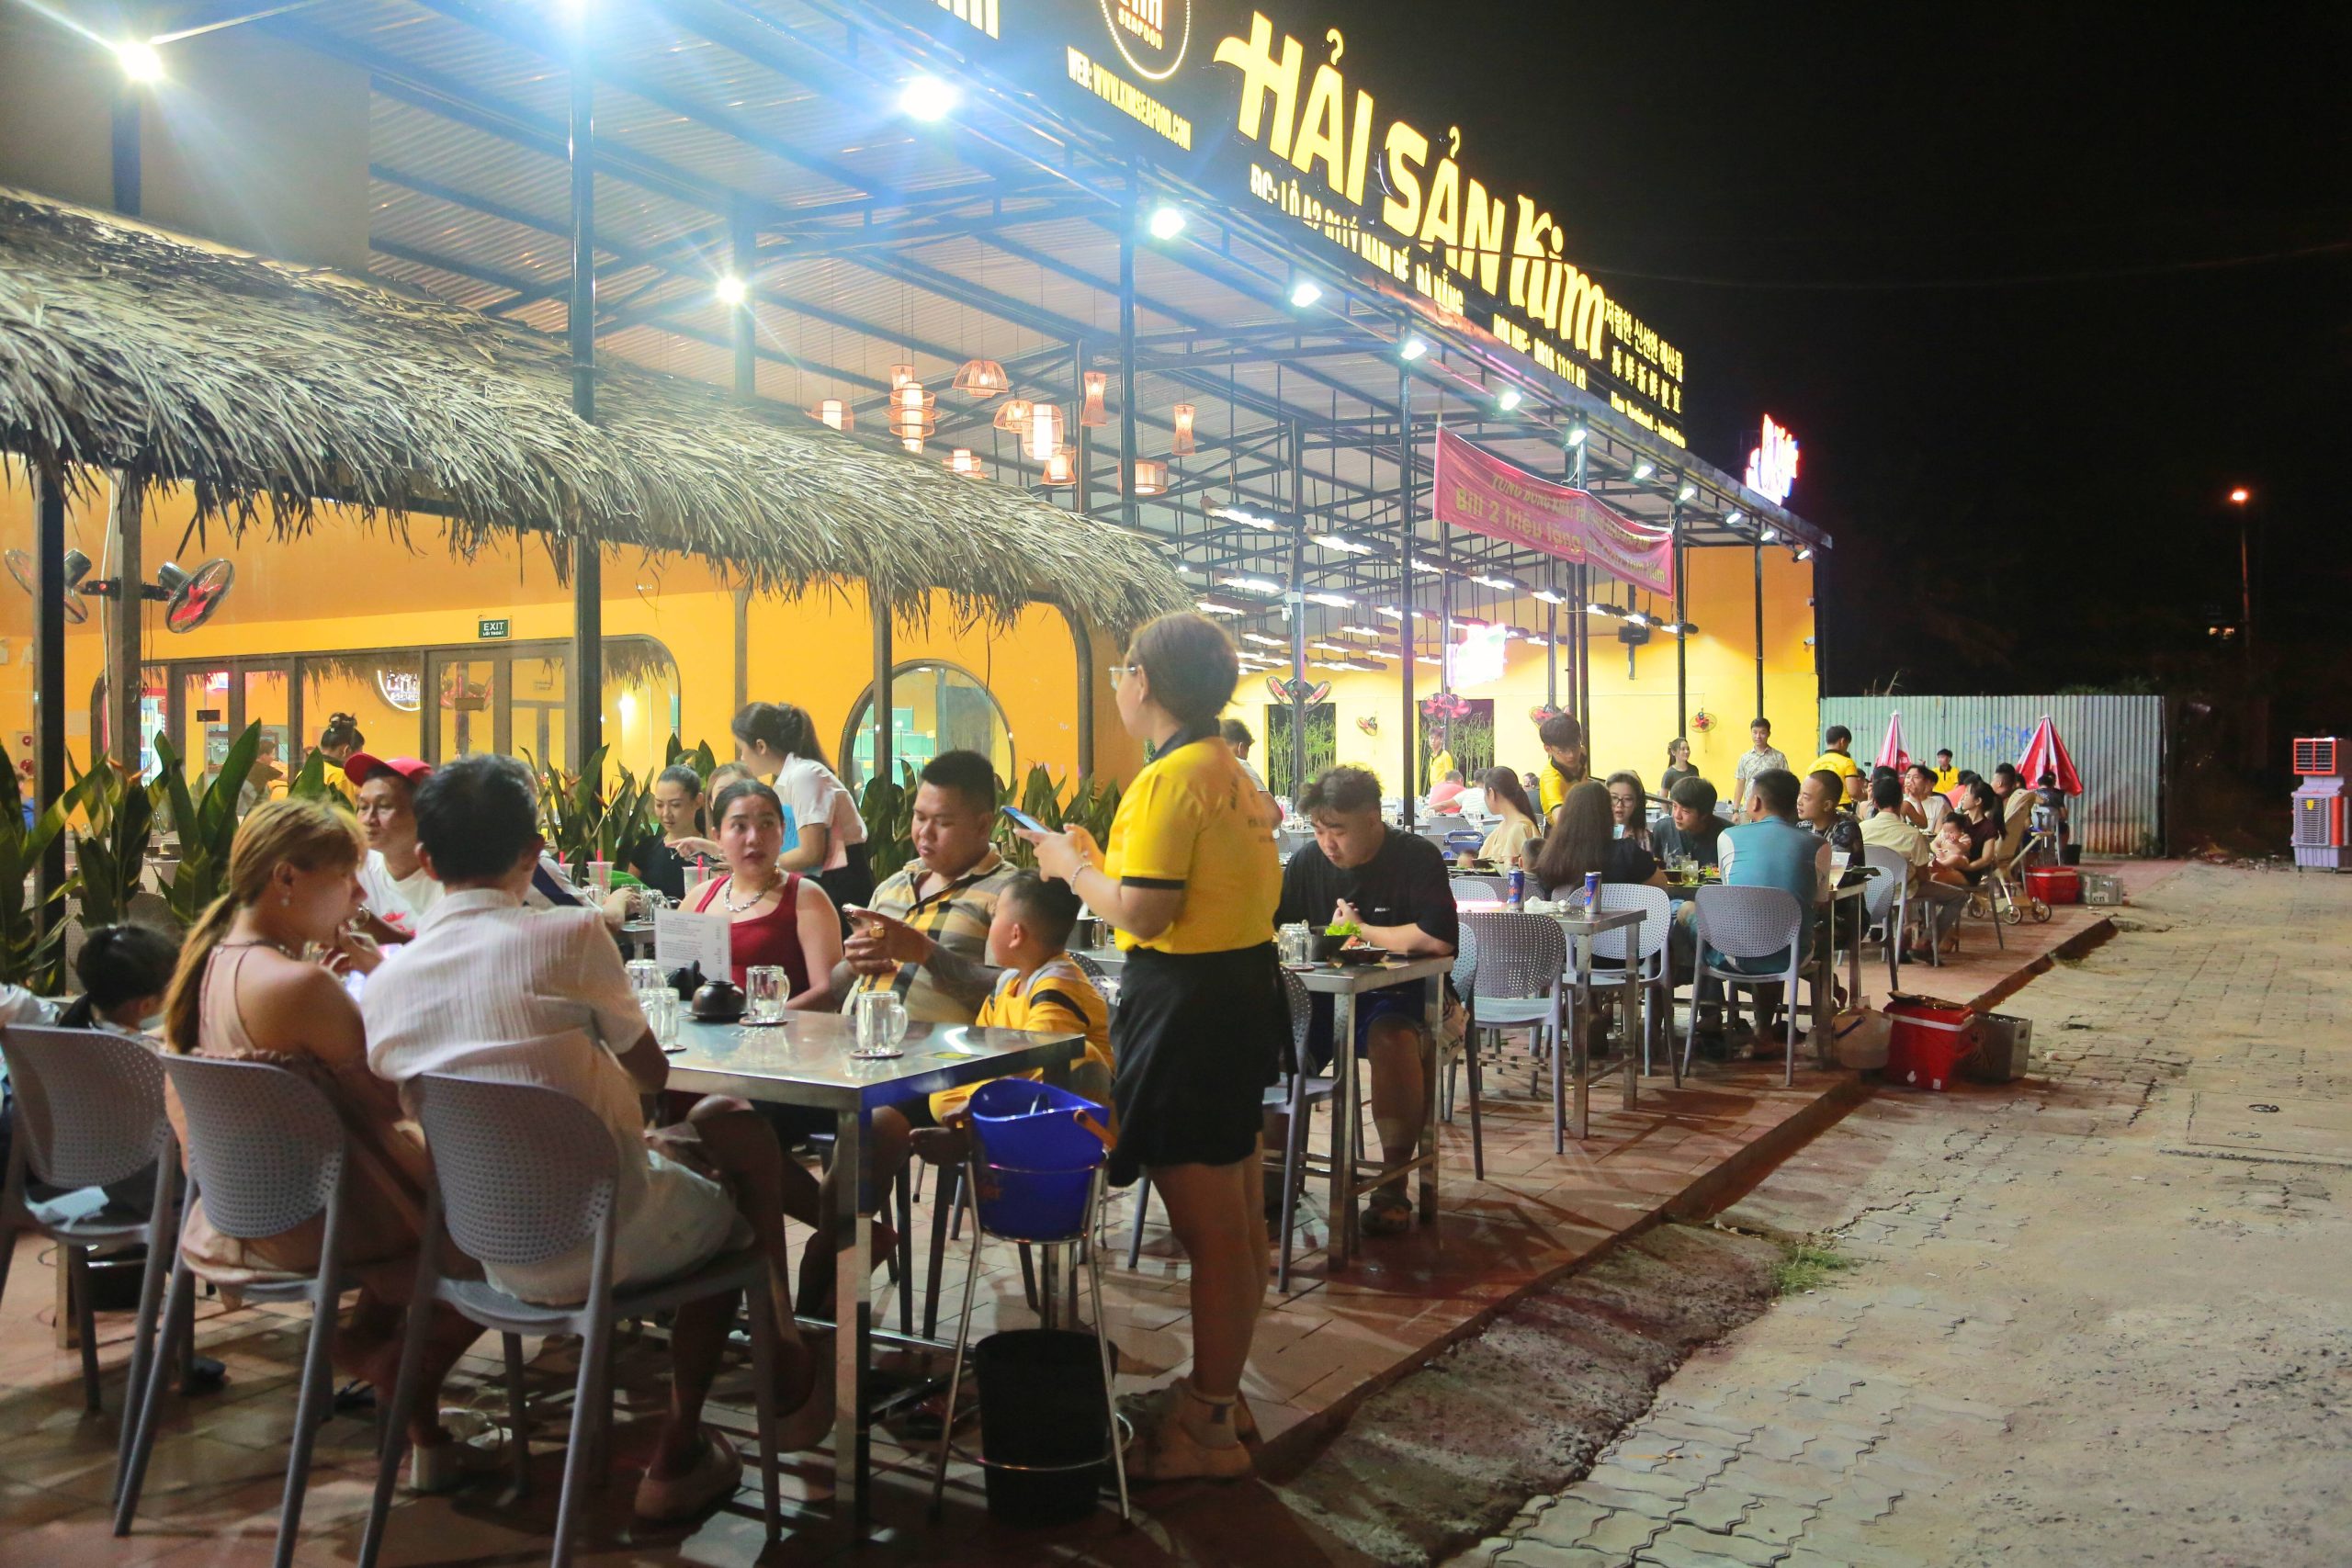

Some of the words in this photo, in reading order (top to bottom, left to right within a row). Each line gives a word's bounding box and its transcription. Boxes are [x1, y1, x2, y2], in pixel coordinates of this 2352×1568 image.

[1118, 7, 1163, 51] SEAFOOD
[1068, 46, 1092, 90] WEB:
[1214, 11, 1374, 207] HẢI
[1384, 126, 1506, 297] SẢN
[1510, 194, 1606, 360] Kim
[1362, 232, 1392, 274] NAM
[1634, 319, 1658, 366] 신선한
[1659, 341, 1683, 383] 해산물
[1455, 488, 1483, 516] Bill
[1488, 501, 1499, 525] 2
[483, 622, 504, 631] EXIT
